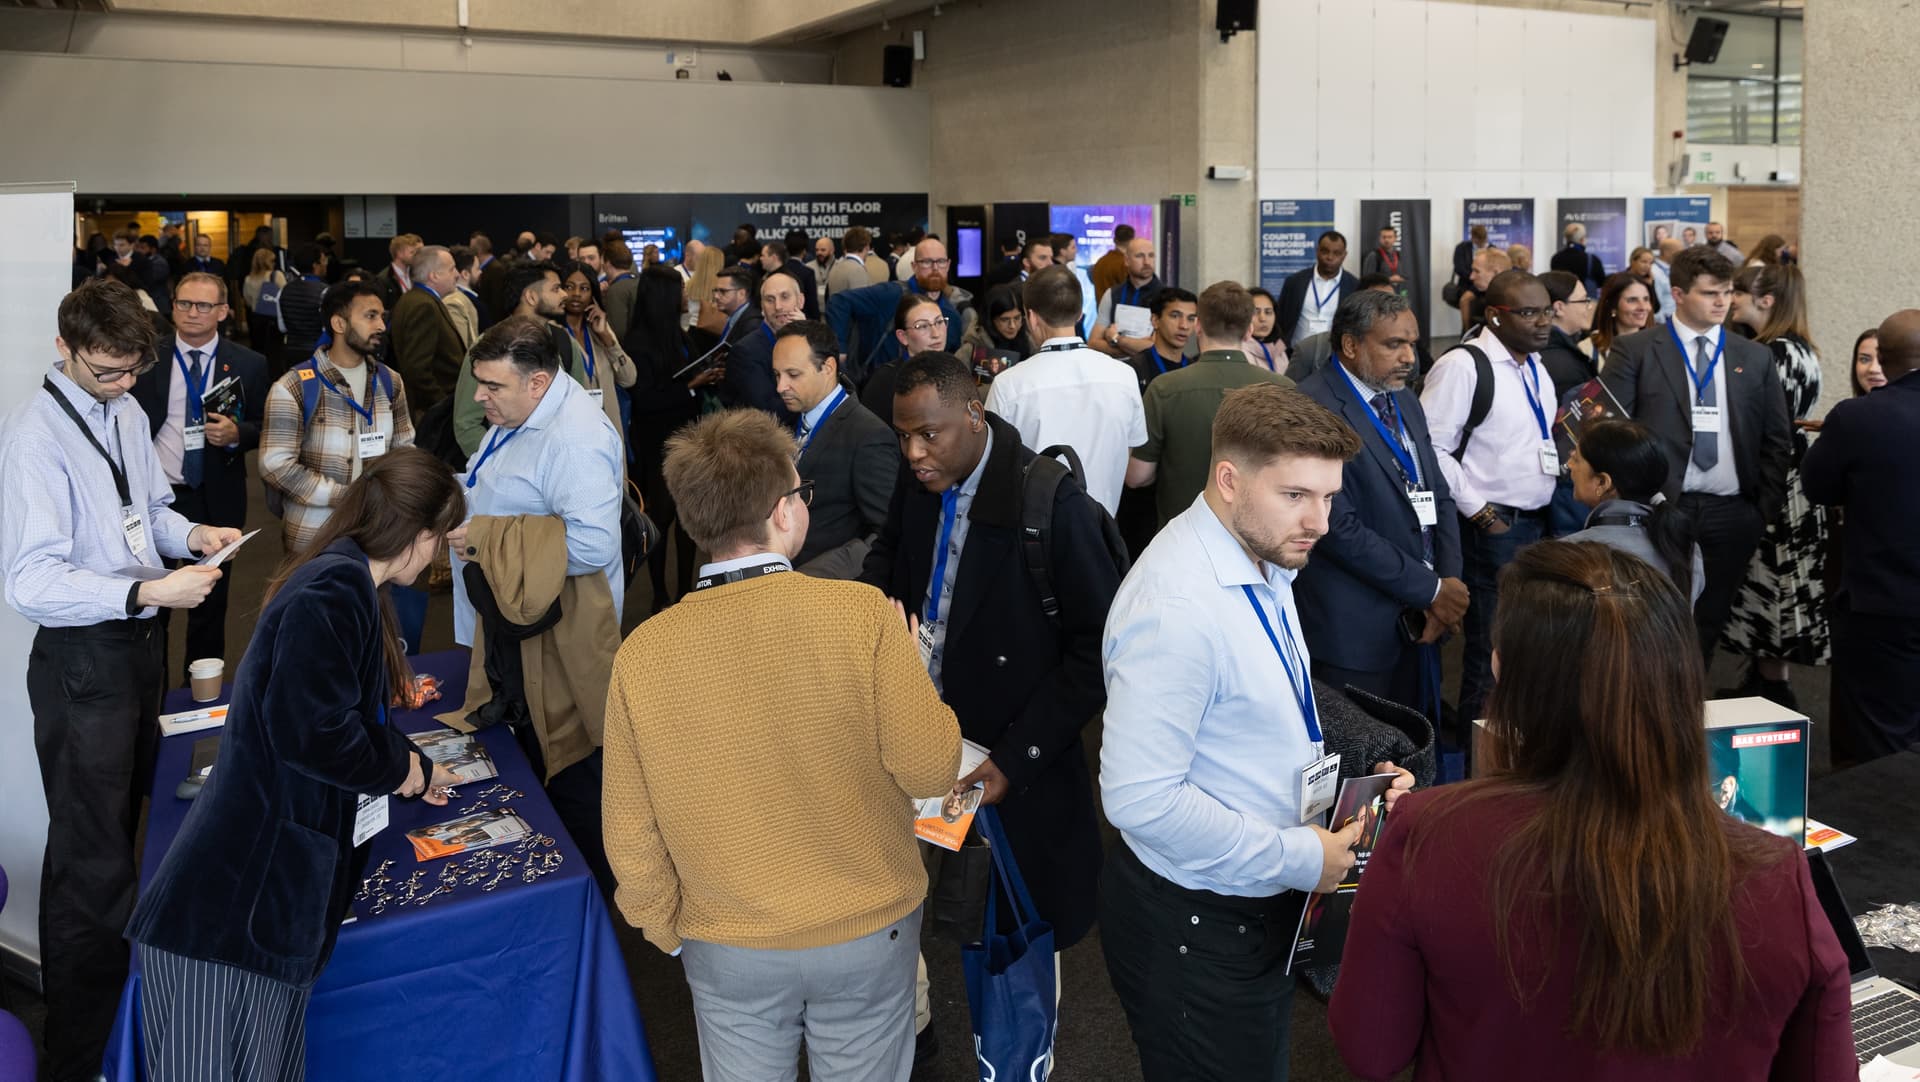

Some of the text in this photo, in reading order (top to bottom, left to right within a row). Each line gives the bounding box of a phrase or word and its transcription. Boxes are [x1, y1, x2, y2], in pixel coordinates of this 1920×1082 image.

[746, 202, 881, 214] VISIT THE 5TH FLOOR
[599, 213, 628, 223] Britten
[781, 215, 849, 226] FOR MORE
[755, 229, 789, 240] ALKS
[1262, 233, 1306, 241] COUNTER
[1263, 241, 1315, 249] TERRORISM
[1262, 248, 1306, 257] POLICING
[1756, 732, 1797, 744] SYSTEMS
